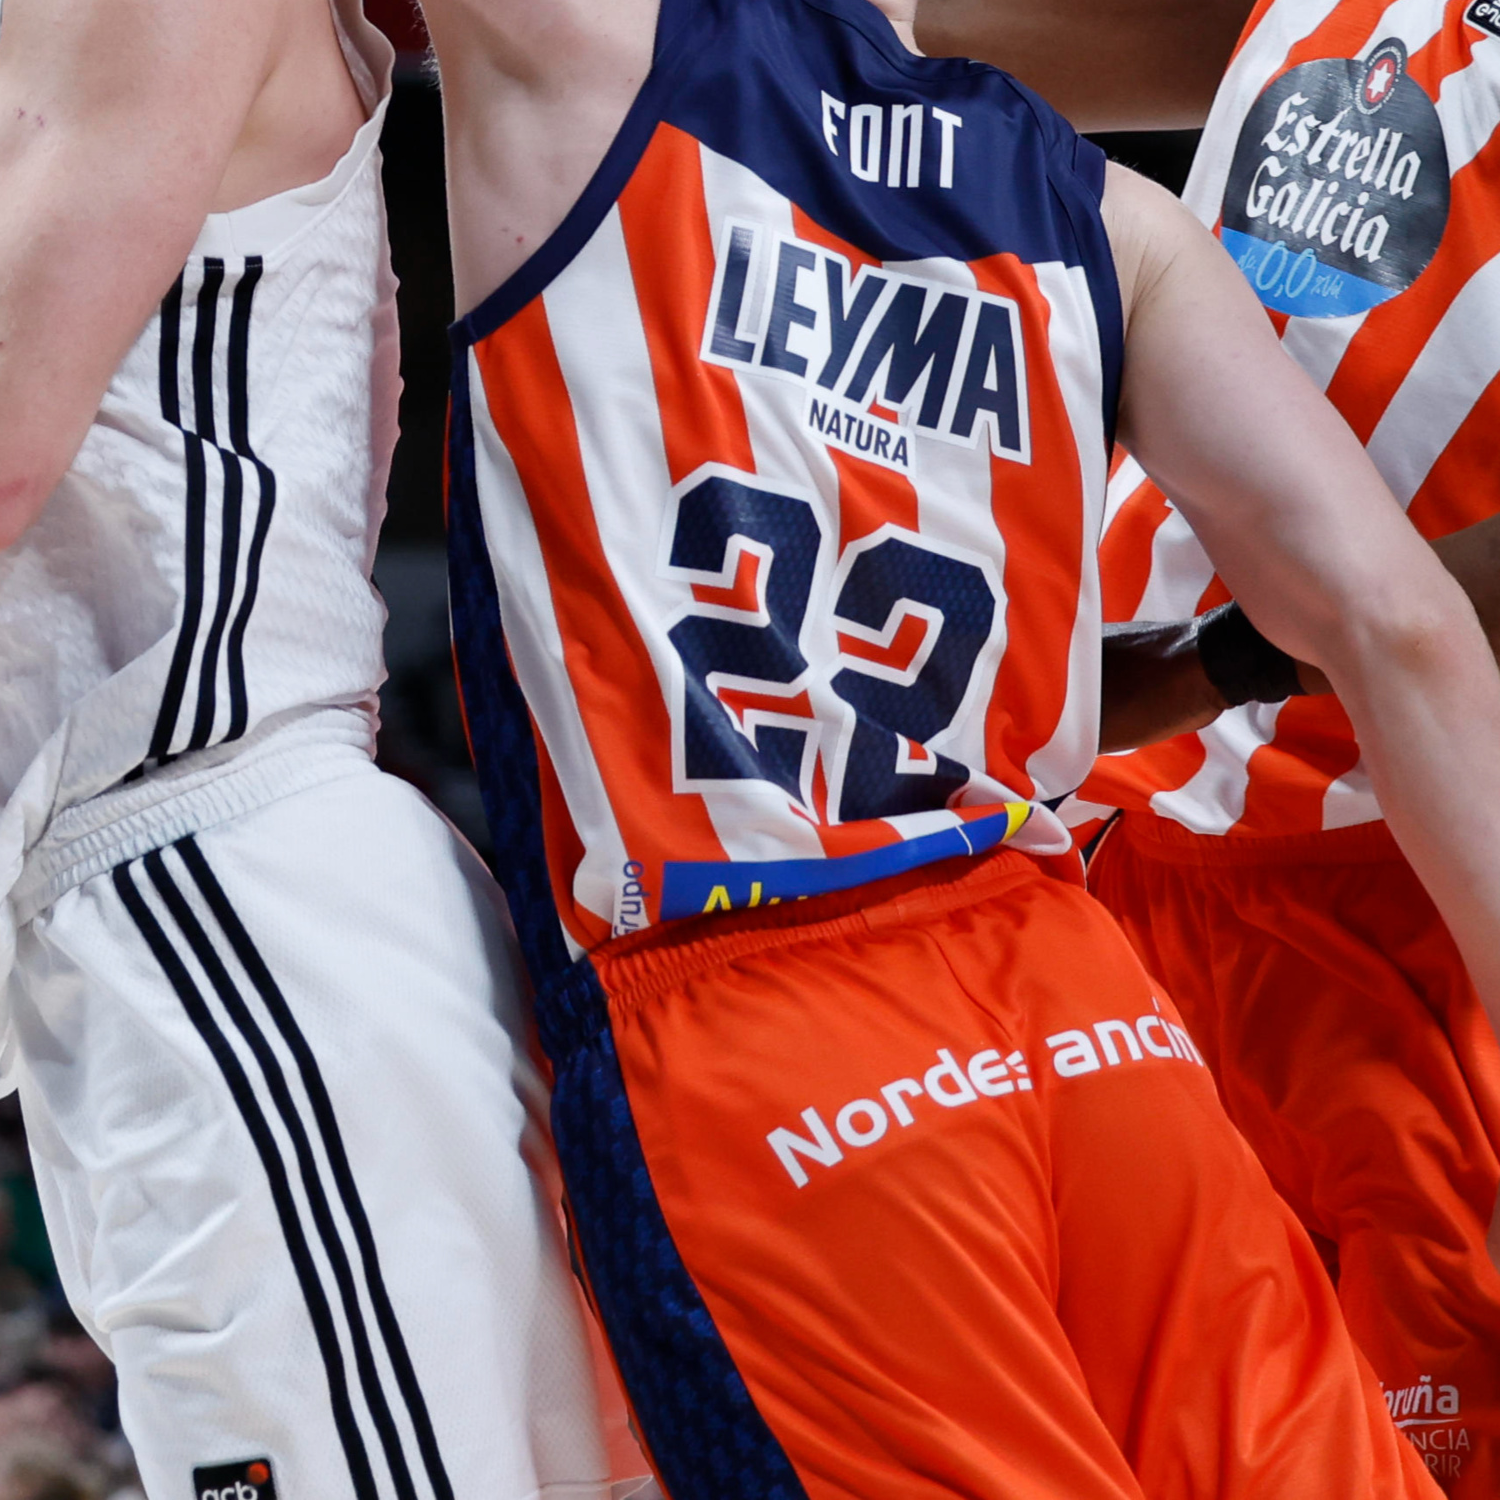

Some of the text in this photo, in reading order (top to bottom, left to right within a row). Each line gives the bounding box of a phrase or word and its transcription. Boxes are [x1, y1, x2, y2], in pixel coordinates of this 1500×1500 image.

[820, 89, 963, 189] FONT
[1261, 92, 1422, 200] Estrella
[1246, 155, 1390, 263] Galicia
[709, 225, 1022, 453] LEYMA
[808, 398, 909, 467] NATURA
[666, 475, 997, 823] 22
[1379, 1375, 1459, 1418] oruña
[1402, 1428, 1470, 1451] NCIA
